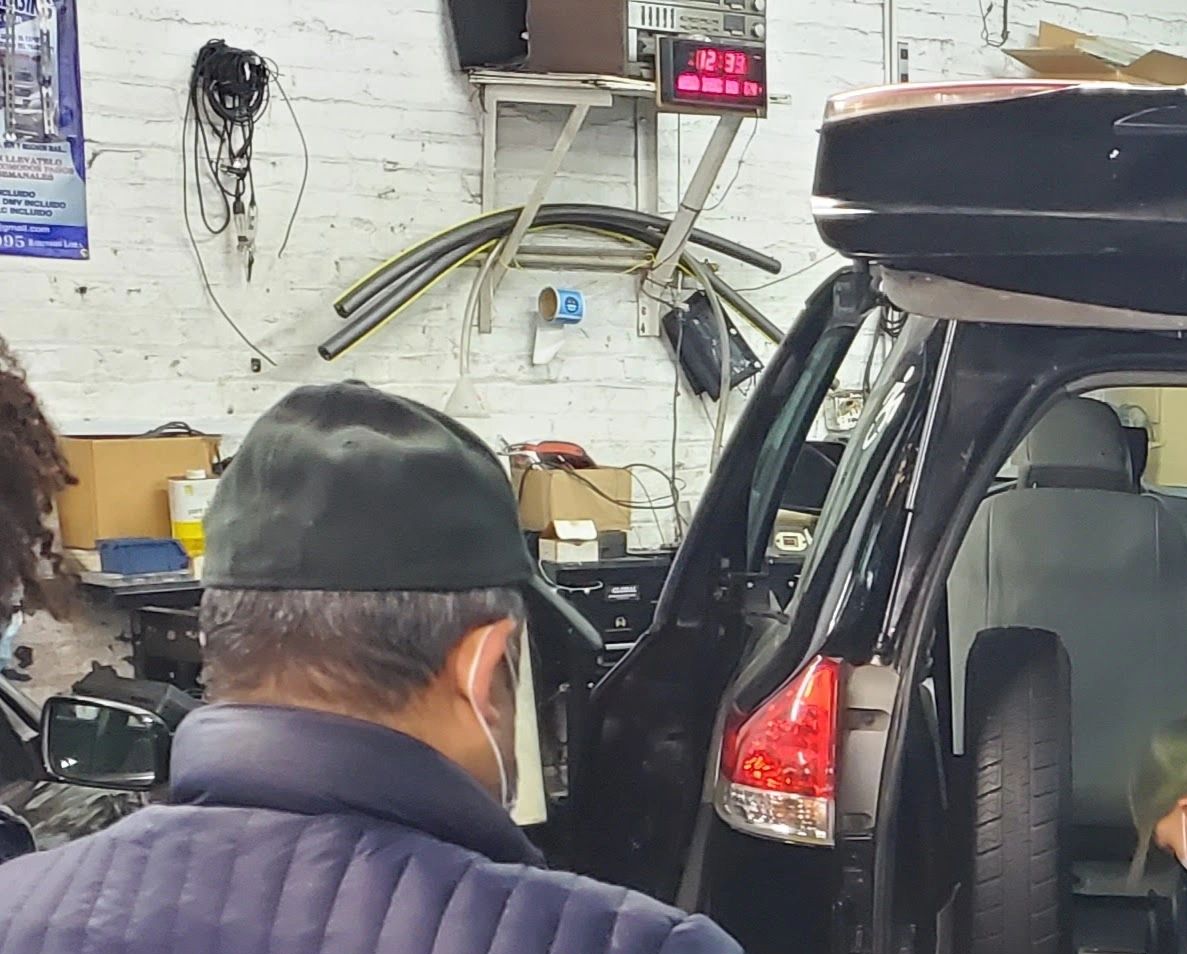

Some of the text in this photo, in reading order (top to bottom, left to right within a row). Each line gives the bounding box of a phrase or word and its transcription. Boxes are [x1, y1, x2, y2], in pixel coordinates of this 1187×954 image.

[24, 200, 66, 208] INCLUIDO
[10, 207, 53, 217] INCLUIDO
[0, 234, 25, 248] 95
